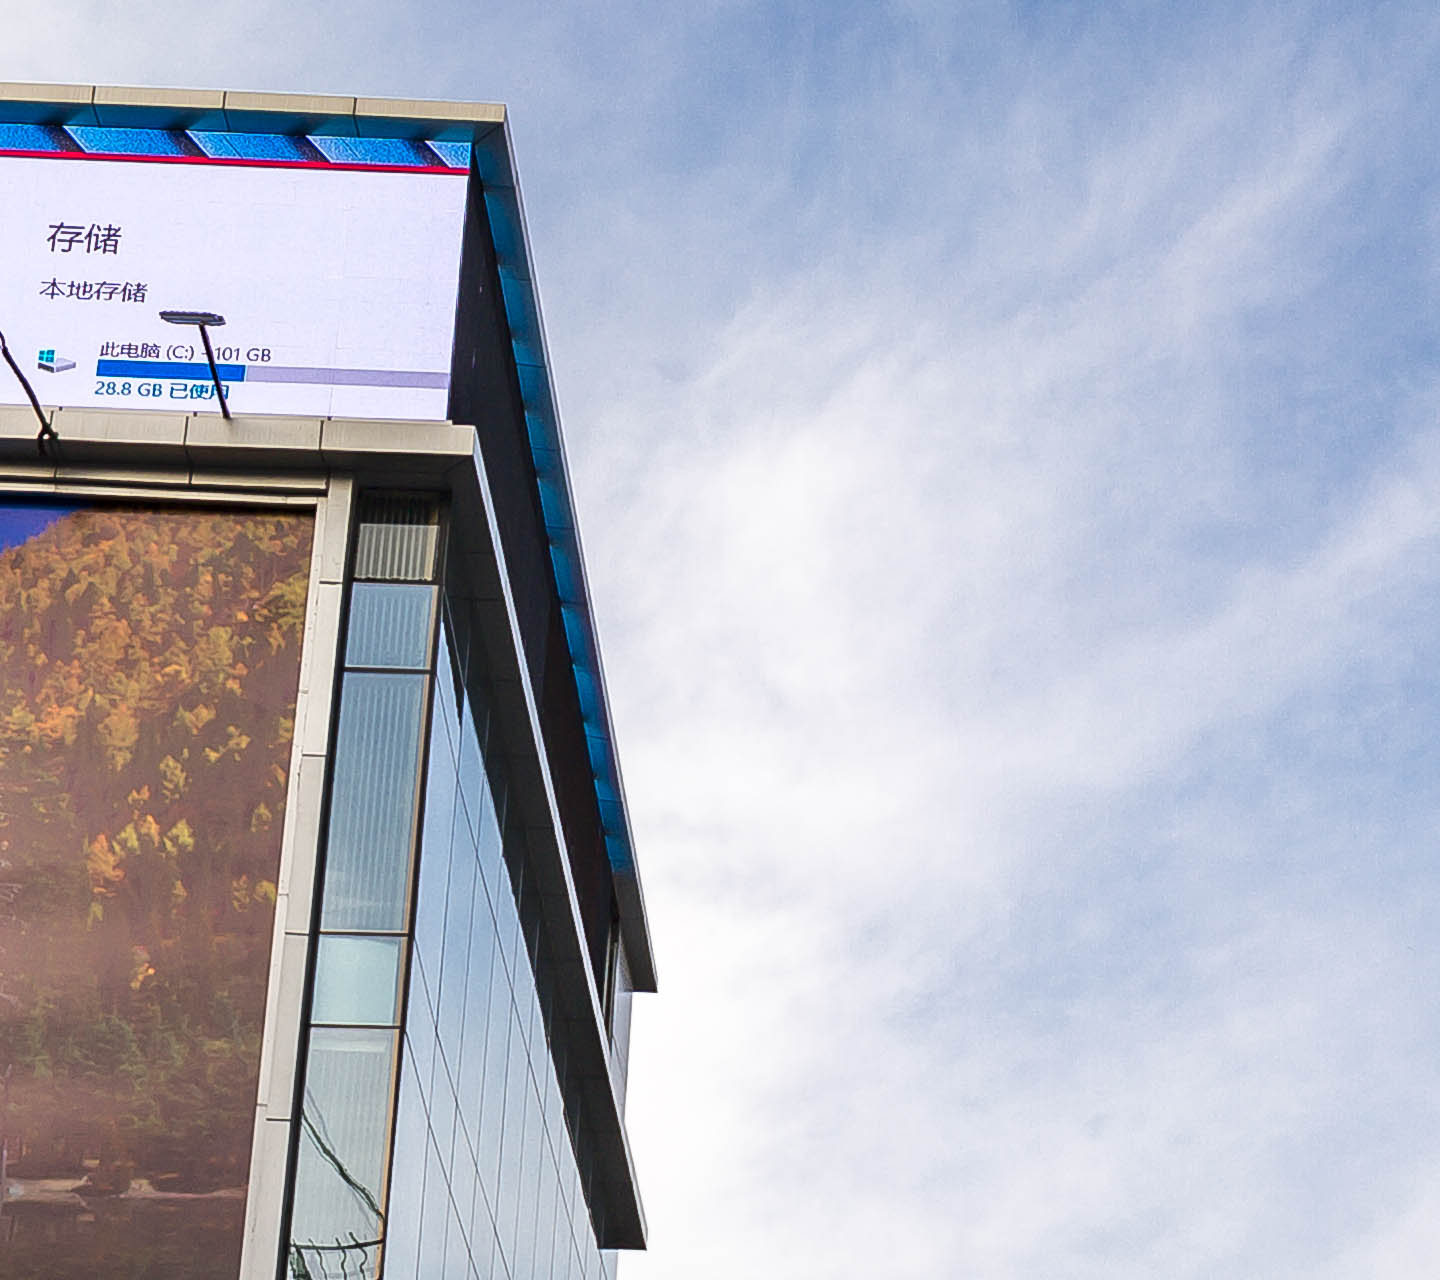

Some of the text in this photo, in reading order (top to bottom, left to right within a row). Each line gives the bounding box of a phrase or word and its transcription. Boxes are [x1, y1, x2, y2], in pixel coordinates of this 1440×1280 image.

[47, 222, 122, 255] 存储
[39, 279, 148, 303] 本地存储
[100, 342, 160, 361] 此电脑
[213, 345, 243, 363] 101
[246, 346, 272, 363] GB
[94, 380, 230, 401] 28.8 GB 已使用
